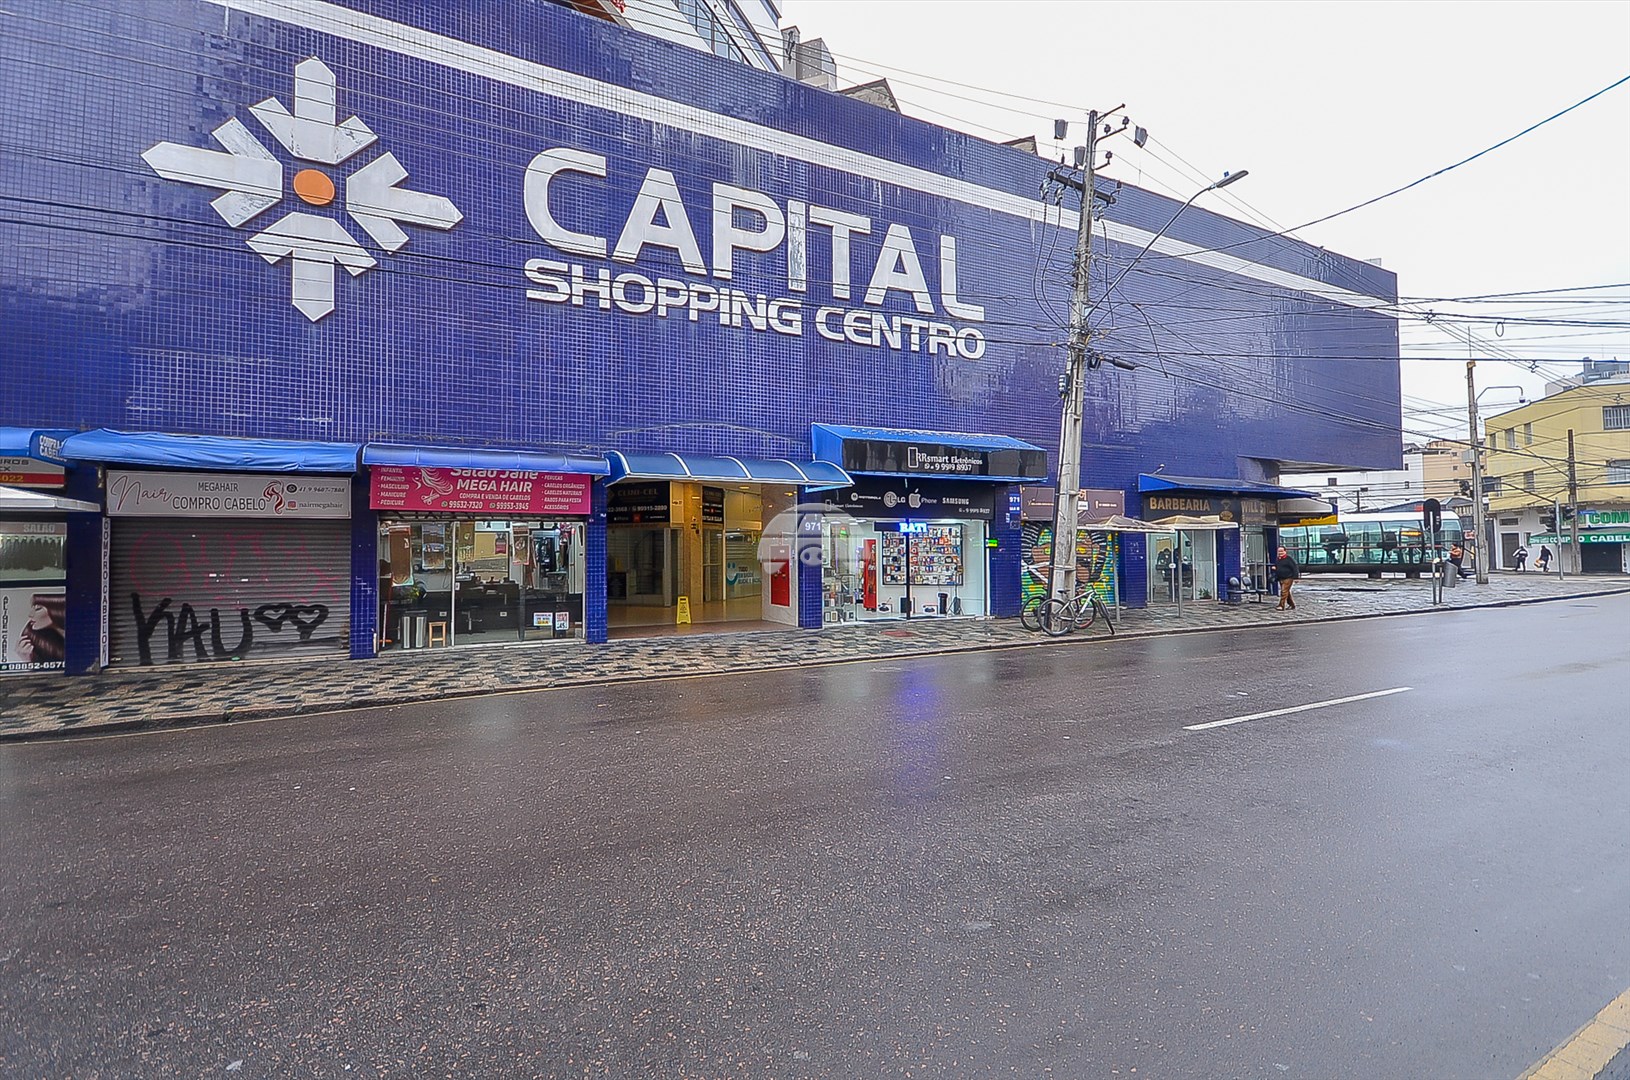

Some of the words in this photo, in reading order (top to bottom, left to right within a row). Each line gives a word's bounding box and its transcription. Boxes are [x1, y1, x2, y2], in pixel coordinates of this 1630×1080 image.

[524, 147, 986, 320] CAPITAL
[524, 258, 803, 335] SHOPPING
[815, 307, 986, 360] CENTRO
[198, 482, 239, 492] MEGAHAIR
[456, 479, 497, 491] MEGA
[500, 481, 533, 492] HAIR
[110, 475, 173, 511] Nair
[172, 496, 221, 510] COMPRO
[224, 498, 266, 511] CABELO
[942, 497, 970, 505] SAMSUNG
[1149, 497, 1211, 511] BARBEARIA
[1241, 501, 1259, 512] WILL
[804, 522, 821, 530] 971
